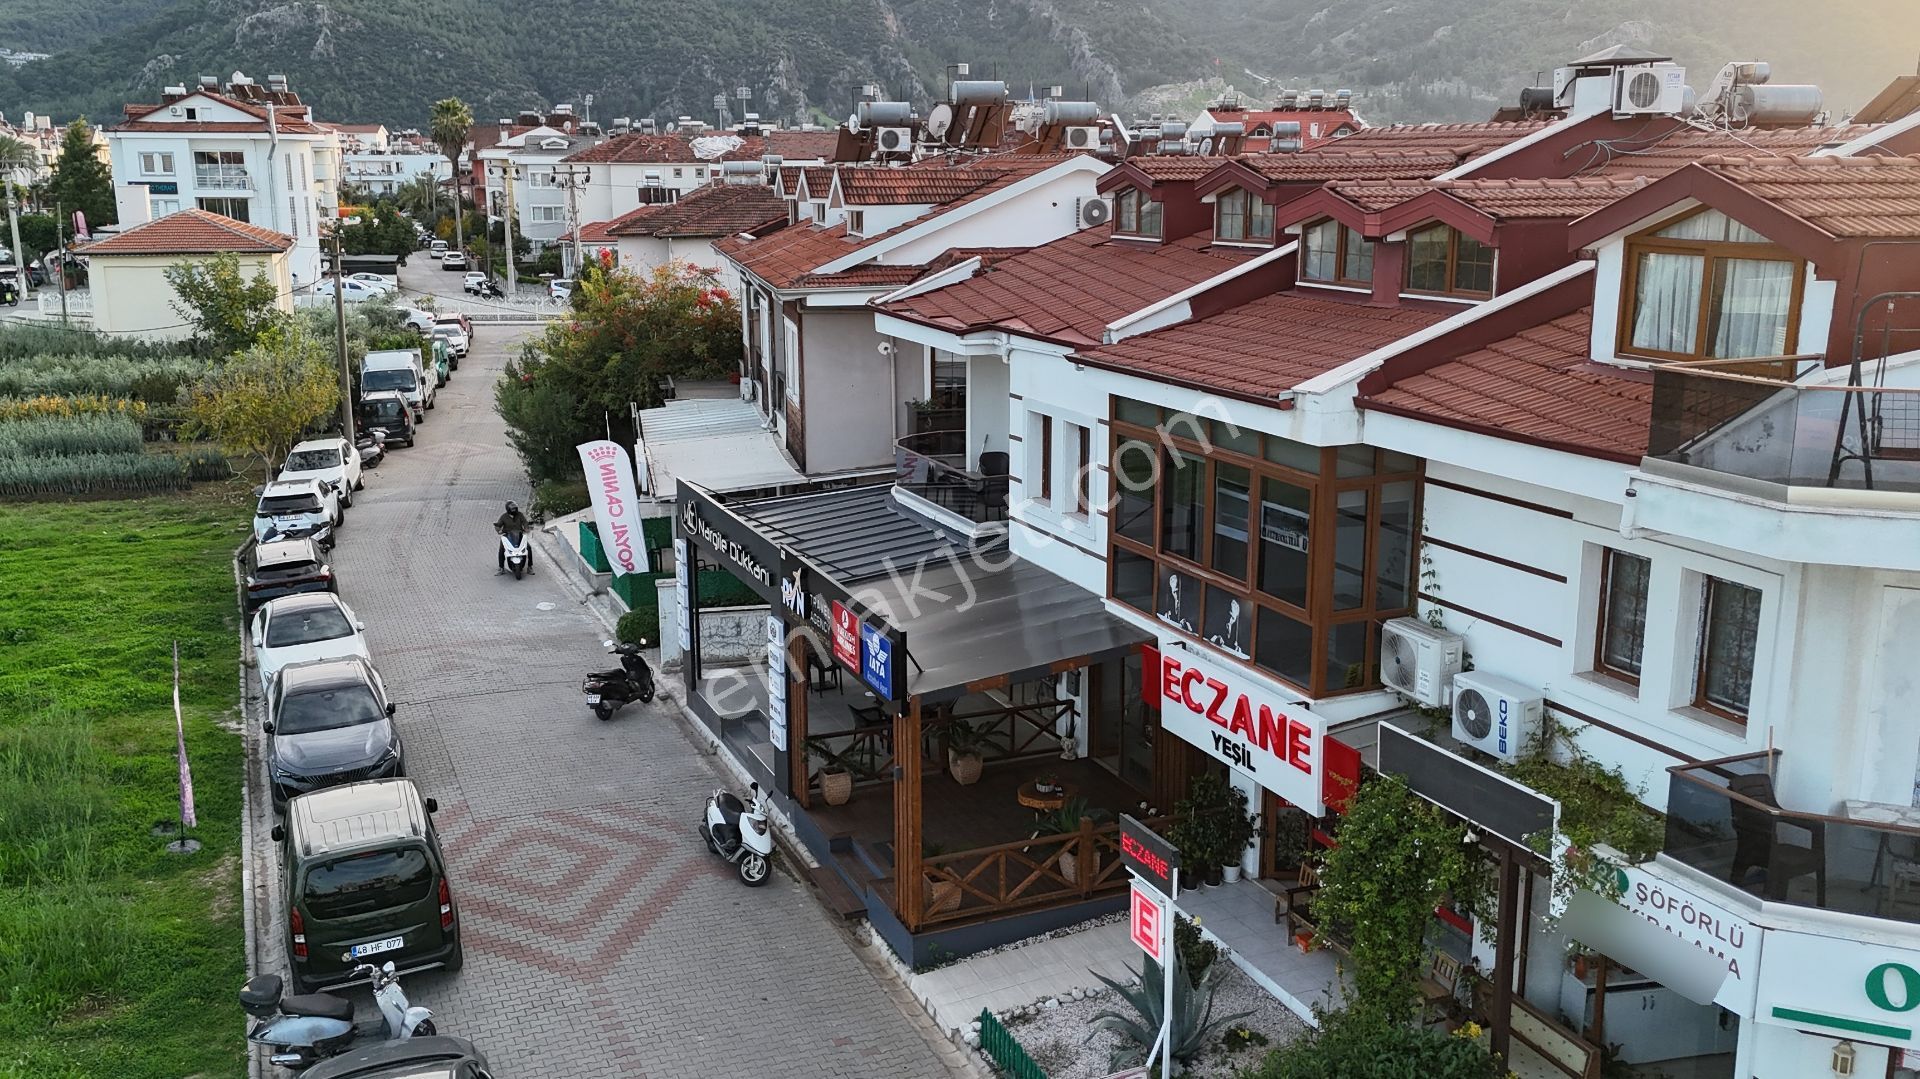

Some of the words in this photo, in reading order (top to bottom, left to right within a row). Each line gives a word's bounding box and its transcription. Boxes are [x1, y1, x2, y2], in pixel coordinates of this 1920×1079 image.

[698, 518, 728, 553] Nargile
[729, 541, 771, 587] Dükkanı
[868, 655, 886, 679] IATA
[1163, 656, 1312, 775] ECZANE
[1498, 699, 1509, 754] BEKO
[1211, 730, 1257, 773] YEŞİL
[1121, 831, 1169, 881] ECZANE
[1139, 899, 1154, 947] E
[1635, 882, 1745, 949] ŞÖFÖRLÜ
[357, 945, 368, 955] 48
[371, 942, 383, 953] HF
[386, 938, 402, 949] 077
